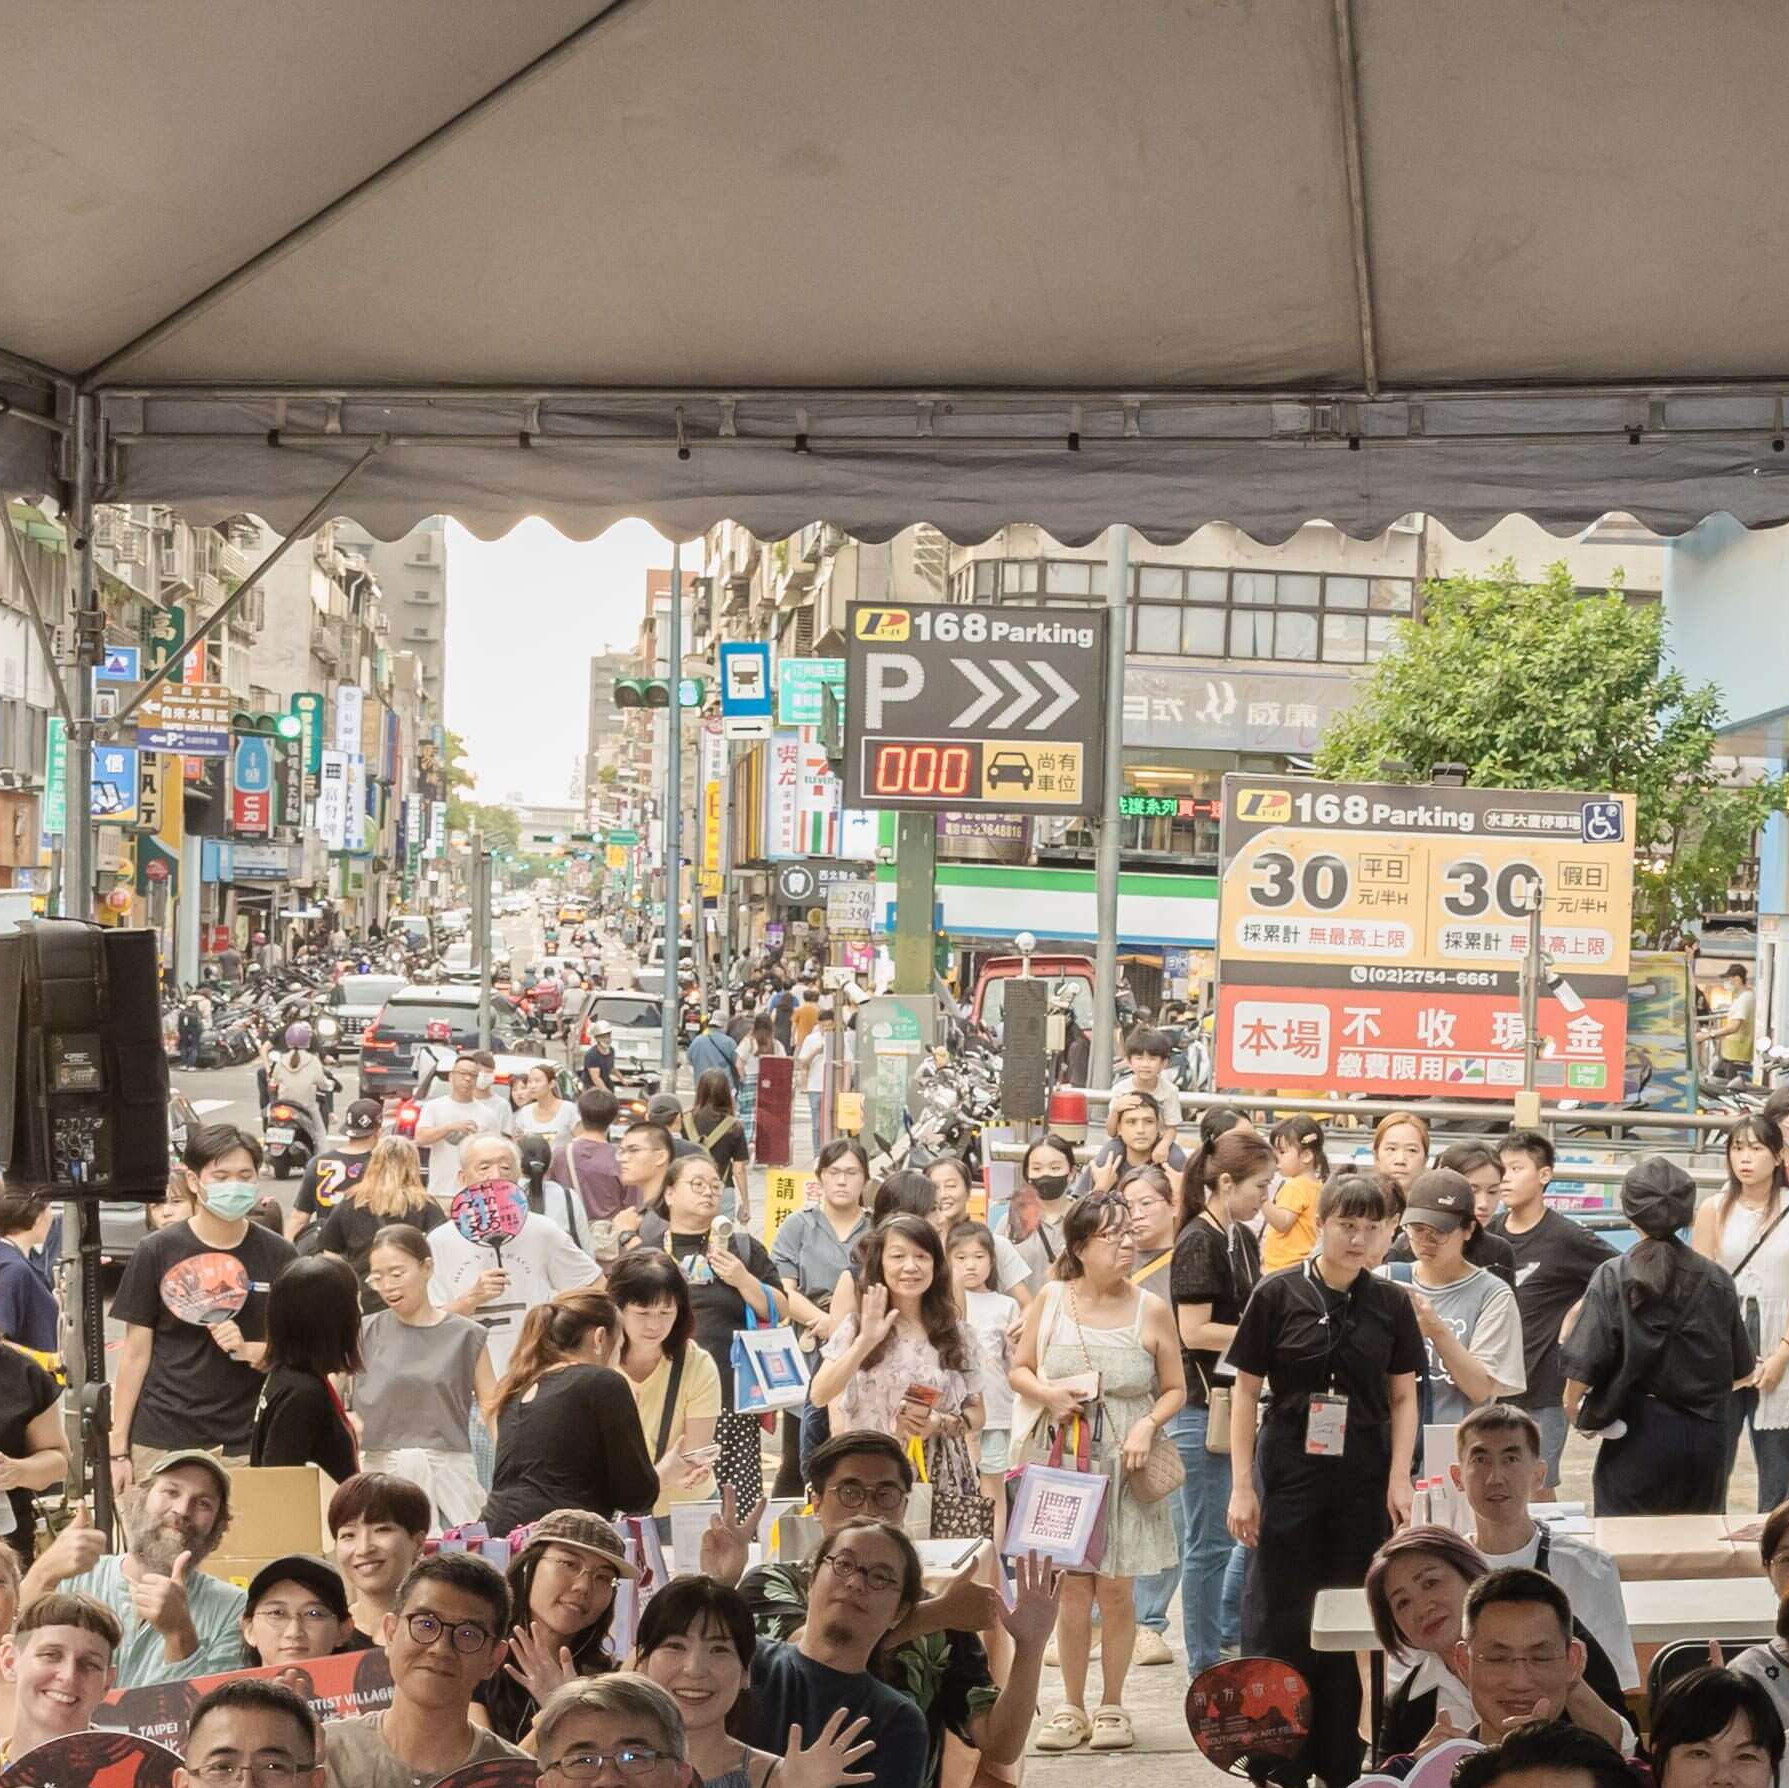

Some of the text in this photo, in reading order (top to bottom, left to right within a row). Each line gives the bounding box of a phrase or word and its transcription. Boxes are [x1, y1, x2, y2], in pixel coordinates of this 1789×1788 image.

[912, 613, 1094, 648] 168 Parking
[865, 652, 926, 730] P
[875, 745, 970, 795] 000
[1036, 752, 1076, 774] 尚有
[1036, 774, 1077, 794] 車位
[1295, 792, 1476, 832] 168 Parking
[1249, 852, 1349, 911] 30
[1363, 857, 1405, 879] 平日
[1563, 865, 1603, 887] 假日
[1445, 861, 1538, 918] 30
[1243, 923, 1406, 949] 採累計 無最高上限
[1444, 932, 1606, 956] 採累計 無高上限
[1368, 967, 1499, 988] (02)2754-6661
[1239, 1015, 1322, 1061] 本場
[1337, 1053, 1444, 1082] 繳費限用
[138, 1721, 179, 1738] TAIPEI
